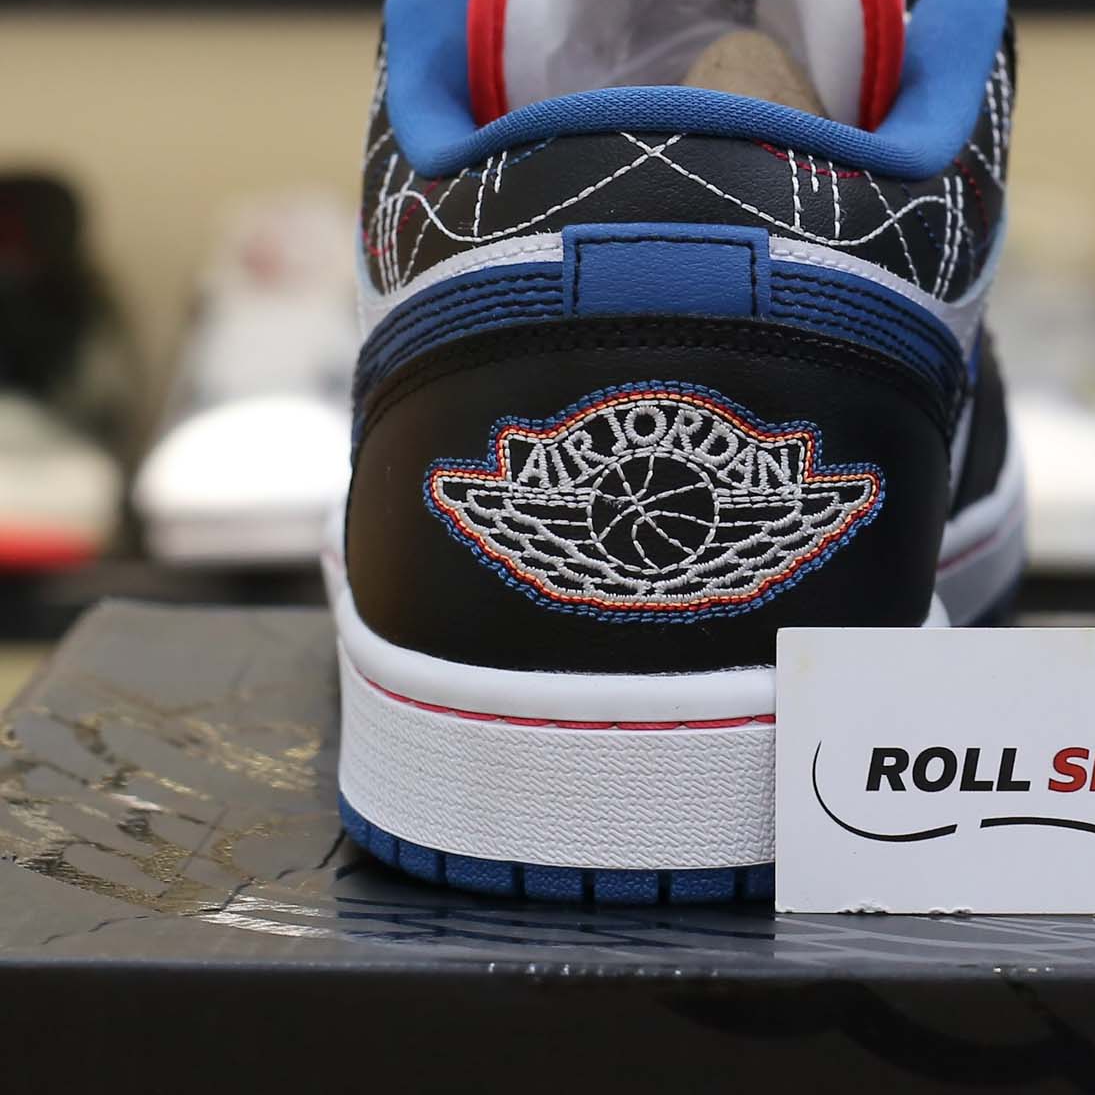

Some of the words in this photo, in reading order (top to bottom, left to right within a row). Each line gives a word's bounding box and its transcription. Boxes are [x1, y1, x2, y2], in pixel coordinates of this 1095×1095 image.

[518, 430, 609, 488] AIR
[605, 405, 793, 489] JORDAN
[866, 747, 1031, 792] ROLL
